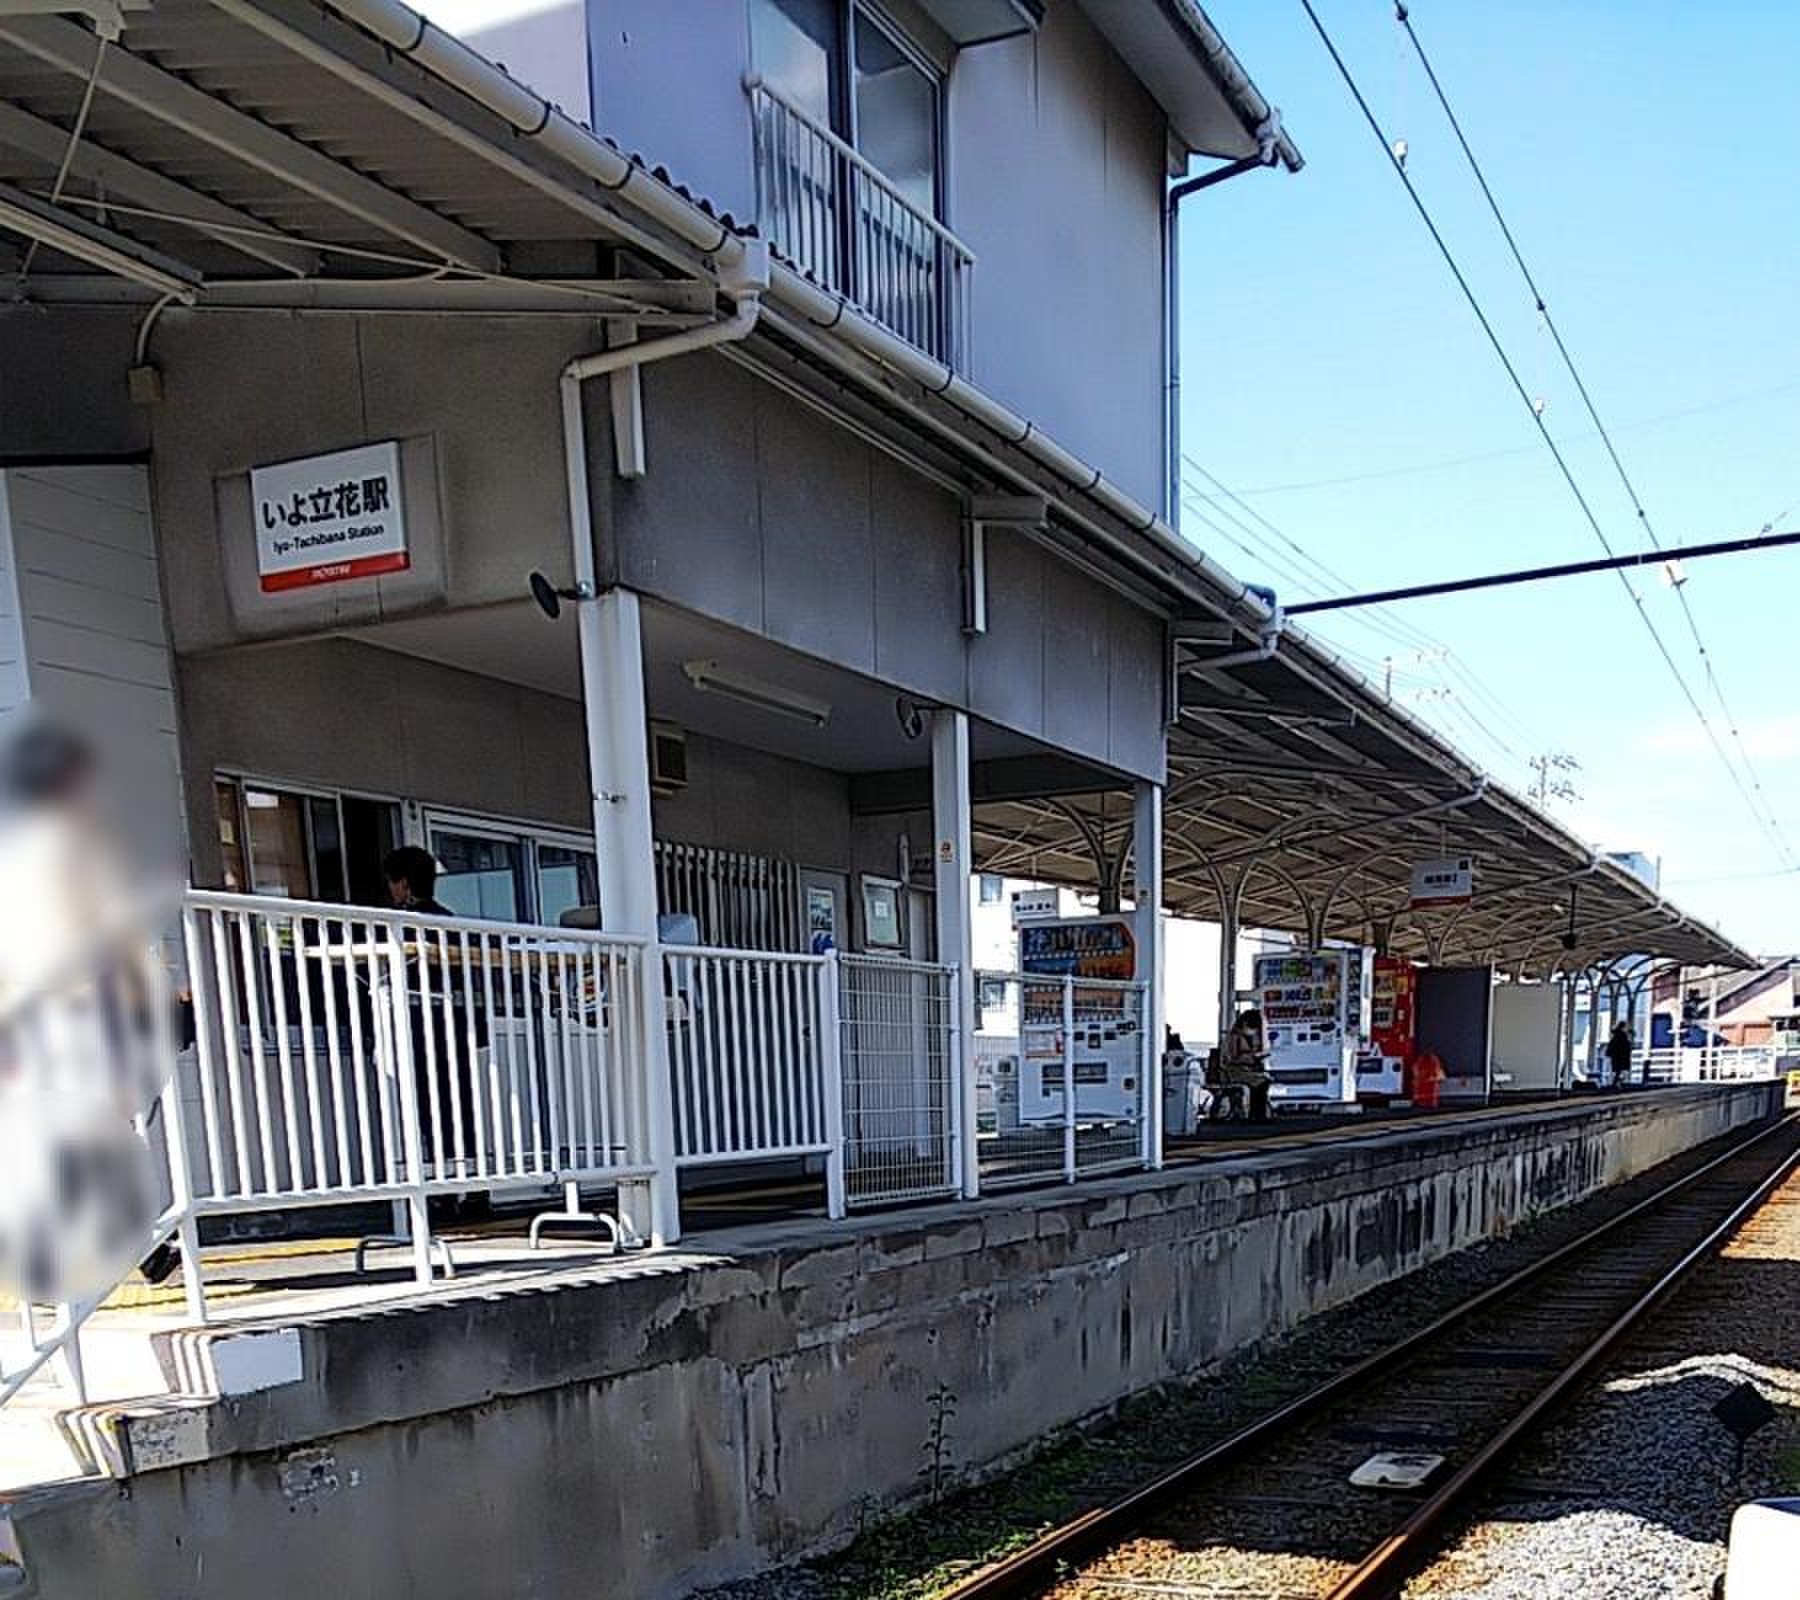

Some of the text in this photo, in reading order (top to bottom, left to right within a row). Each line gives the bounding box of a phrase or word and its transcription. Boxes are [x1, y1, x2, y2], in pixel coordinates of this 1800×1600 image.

[263, 476, 389, 528] いよ立花駅
[273, 524, 385, 555] Iyo-Tachibana Station
